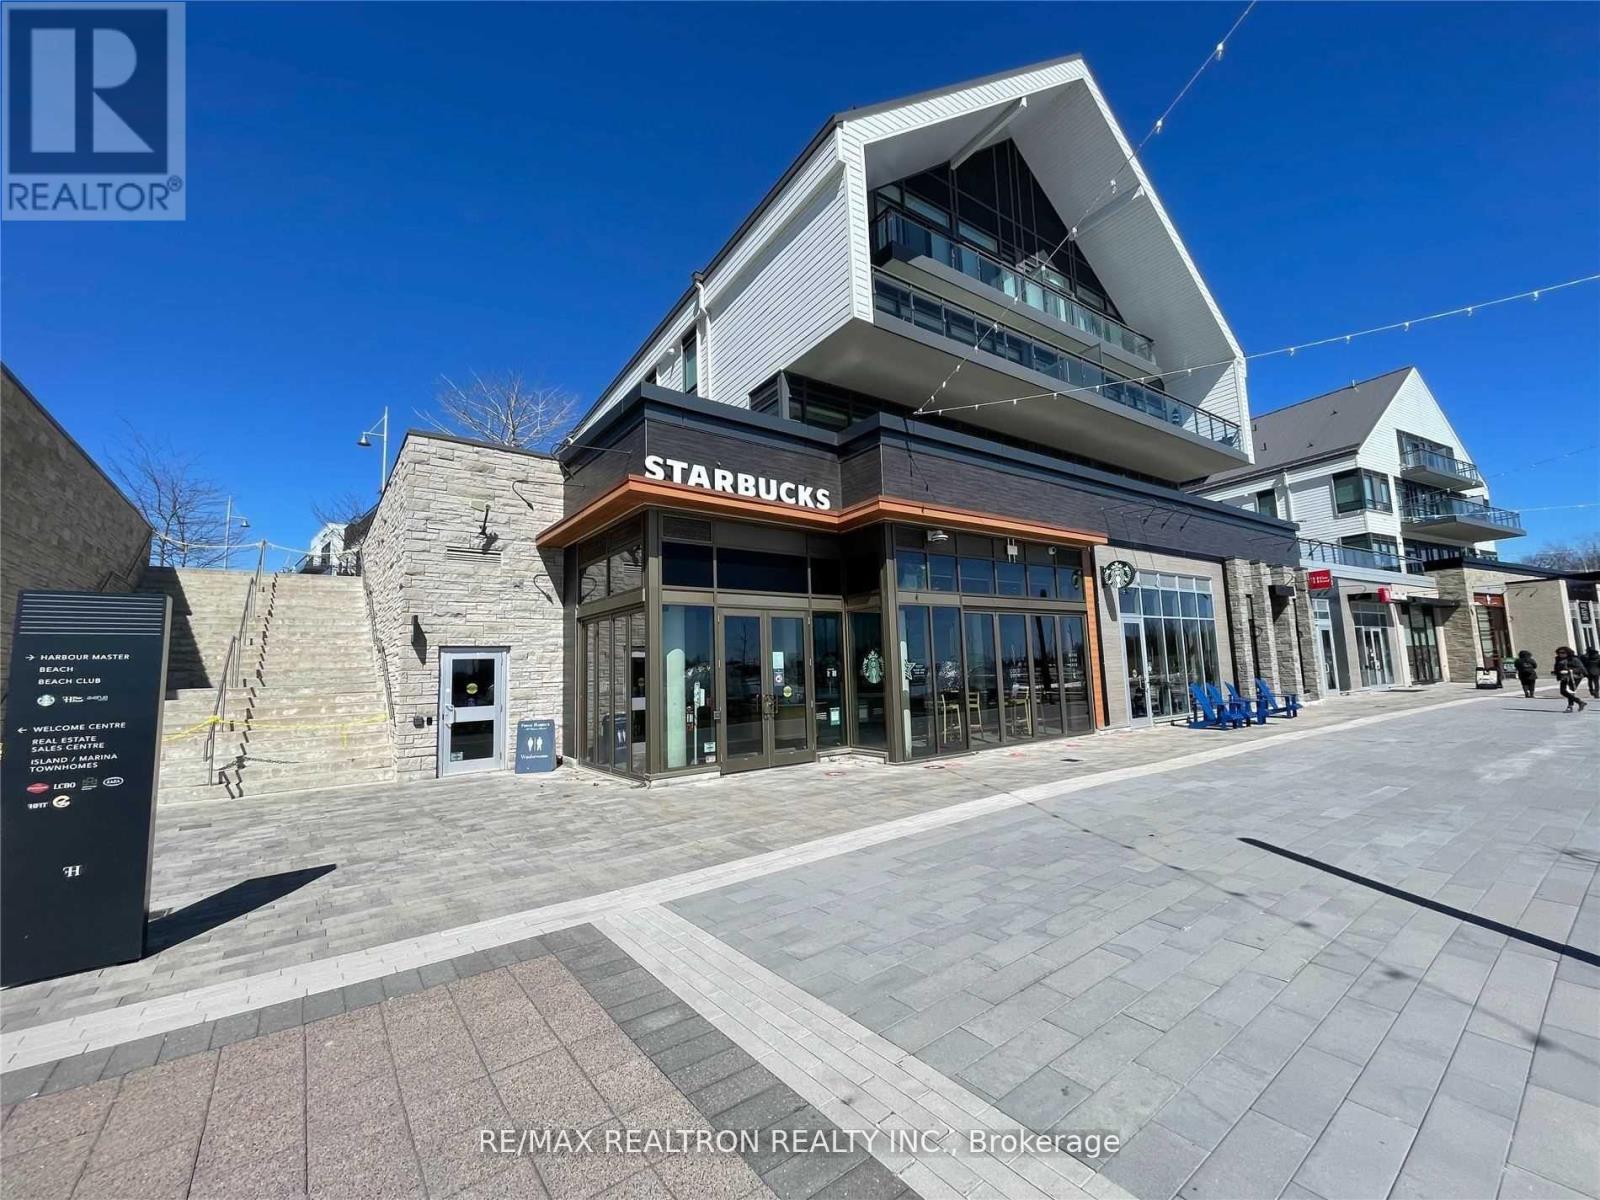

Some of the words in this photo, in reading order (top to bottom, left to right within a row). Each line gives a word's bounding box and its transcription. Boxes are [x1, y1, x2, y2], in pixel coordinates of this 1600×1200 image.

[644, 454, 832, 511] STARBUCKS
[33, 724, 86, 733] WELCOME
[88, 722, 126, 730] CENTRE
[31, 738, 58, 746] REAL
[61, 735, 97, 744] ESTATE
[31, 744, 63, 753] SALES
[65, 742, 105, 751] CENTRE
[30, 757, 68, 766] ISLAND
[79, 753, 118, 762] MARINA
[29, 761, 99, 773] TOWNHOMES
[53, 782, 77, 790] LCBO
